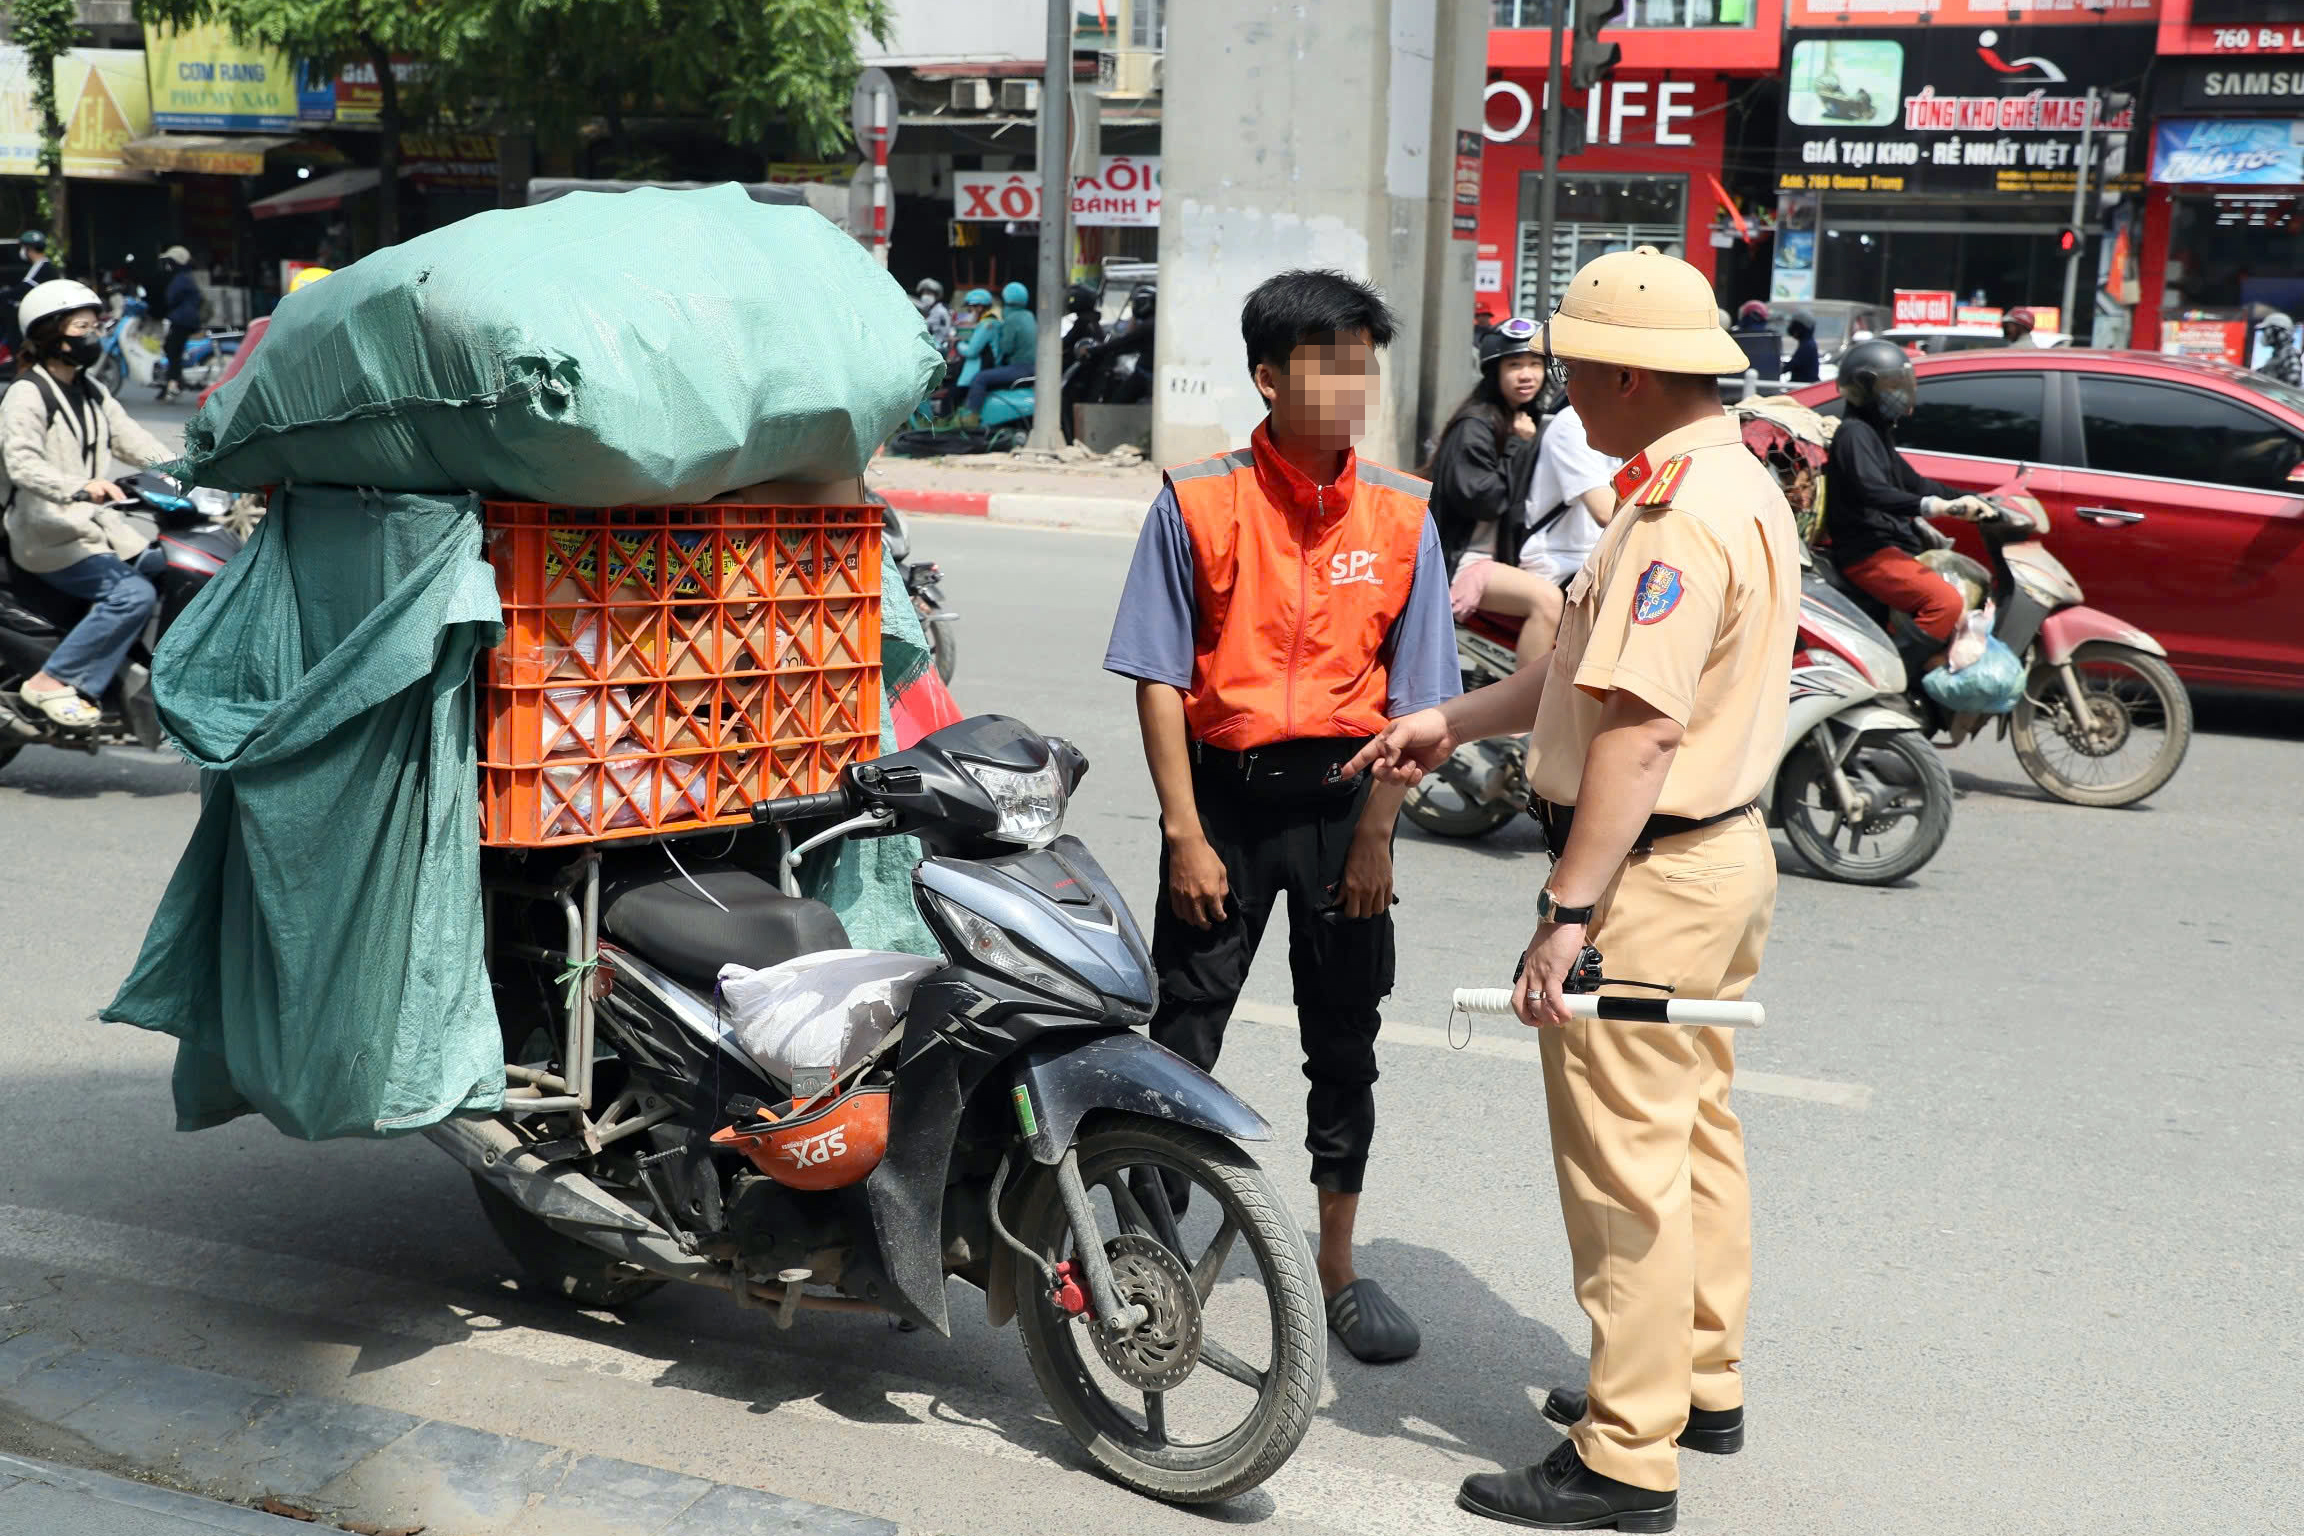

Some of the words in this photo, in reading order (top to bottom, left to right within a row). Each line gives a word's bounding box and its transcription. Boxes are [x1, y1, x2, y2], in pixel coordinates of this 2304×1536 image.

[2213, 28, 2250, 48] 760
[2257, 28, 2284, 48] Ba
[1957, 97, 1998, 131] KHO
[1802, 137, 1838, 164] GIÁ
[1841, 141, 1875, 168] TẠI
[1876, 141, 1919, 165] KHO
[1932, 136, 1962, 165] RẺ
[1964, 137, 2020, 166] NHẤT
[2024, 138, 2071, 170] VIỆT
[1072, 193, 1136, 213] BÁNH
[790, 1132, 847, 1169] SPX
